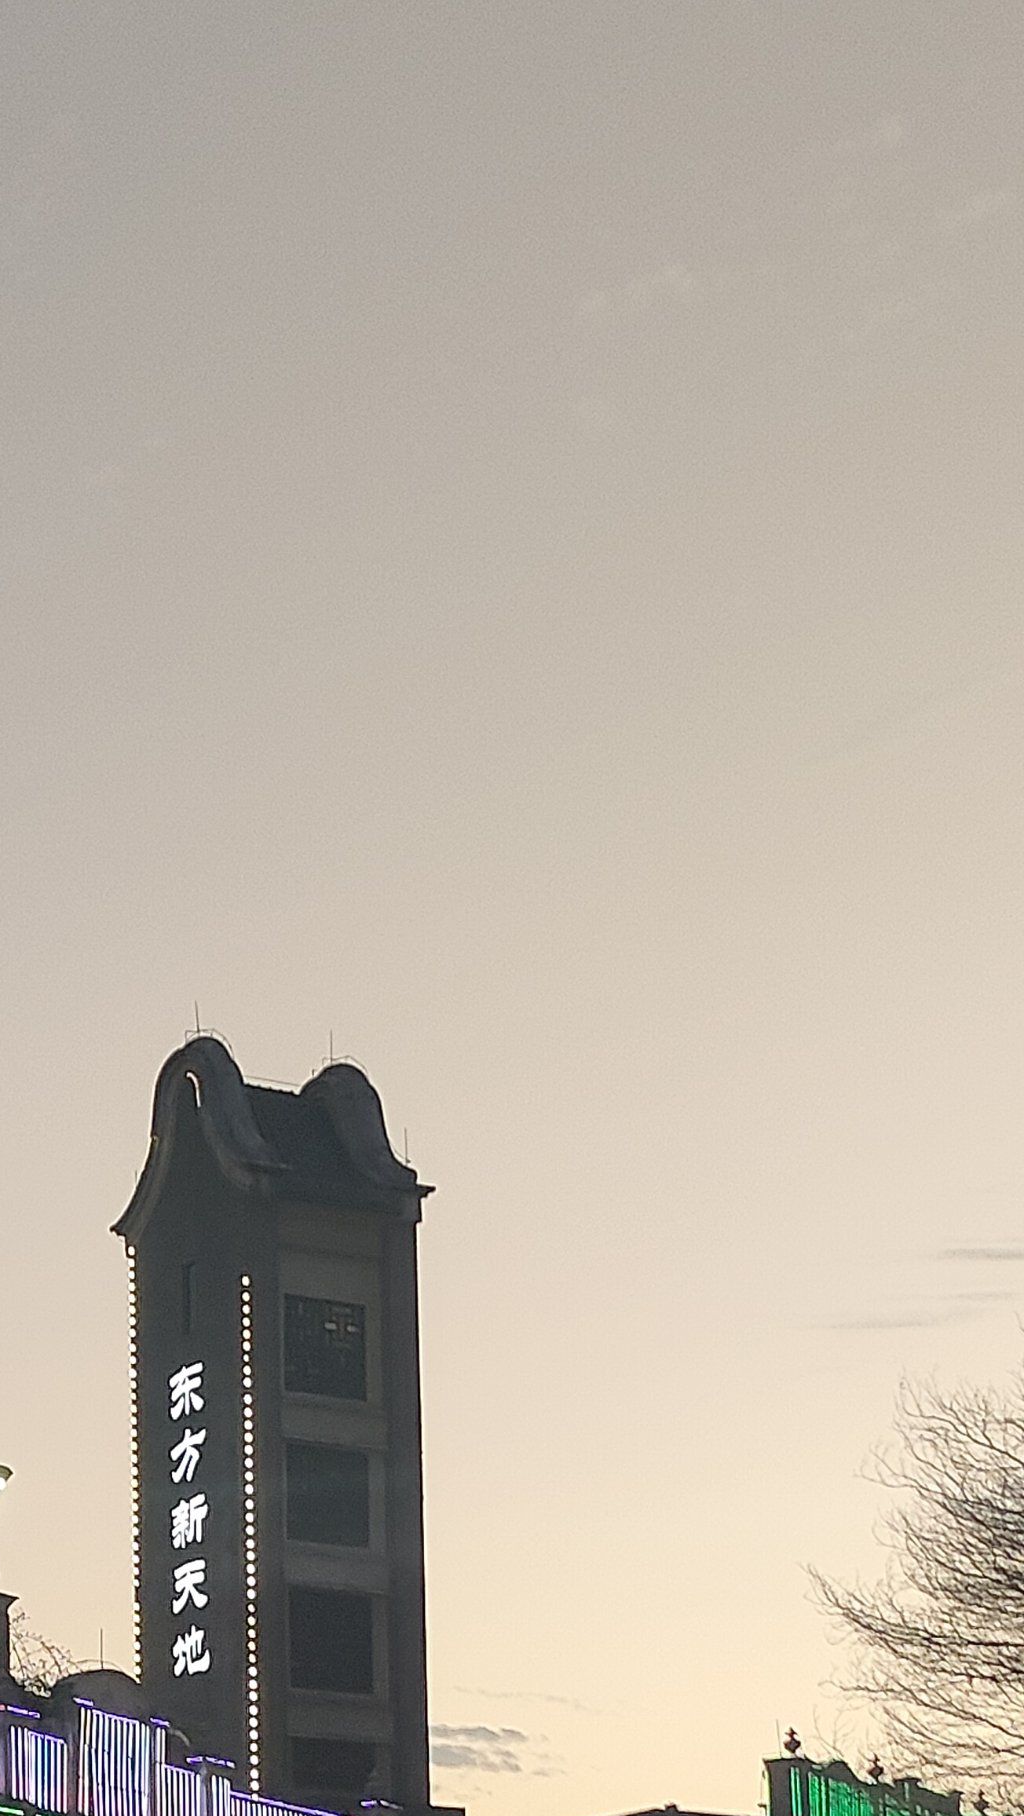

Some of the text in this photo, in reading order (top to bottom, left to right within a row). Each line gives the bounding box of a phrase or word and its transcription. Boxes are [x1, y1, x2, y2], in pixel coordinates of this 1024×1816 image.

[169, 1361, 211, 1677] 东方新天地
